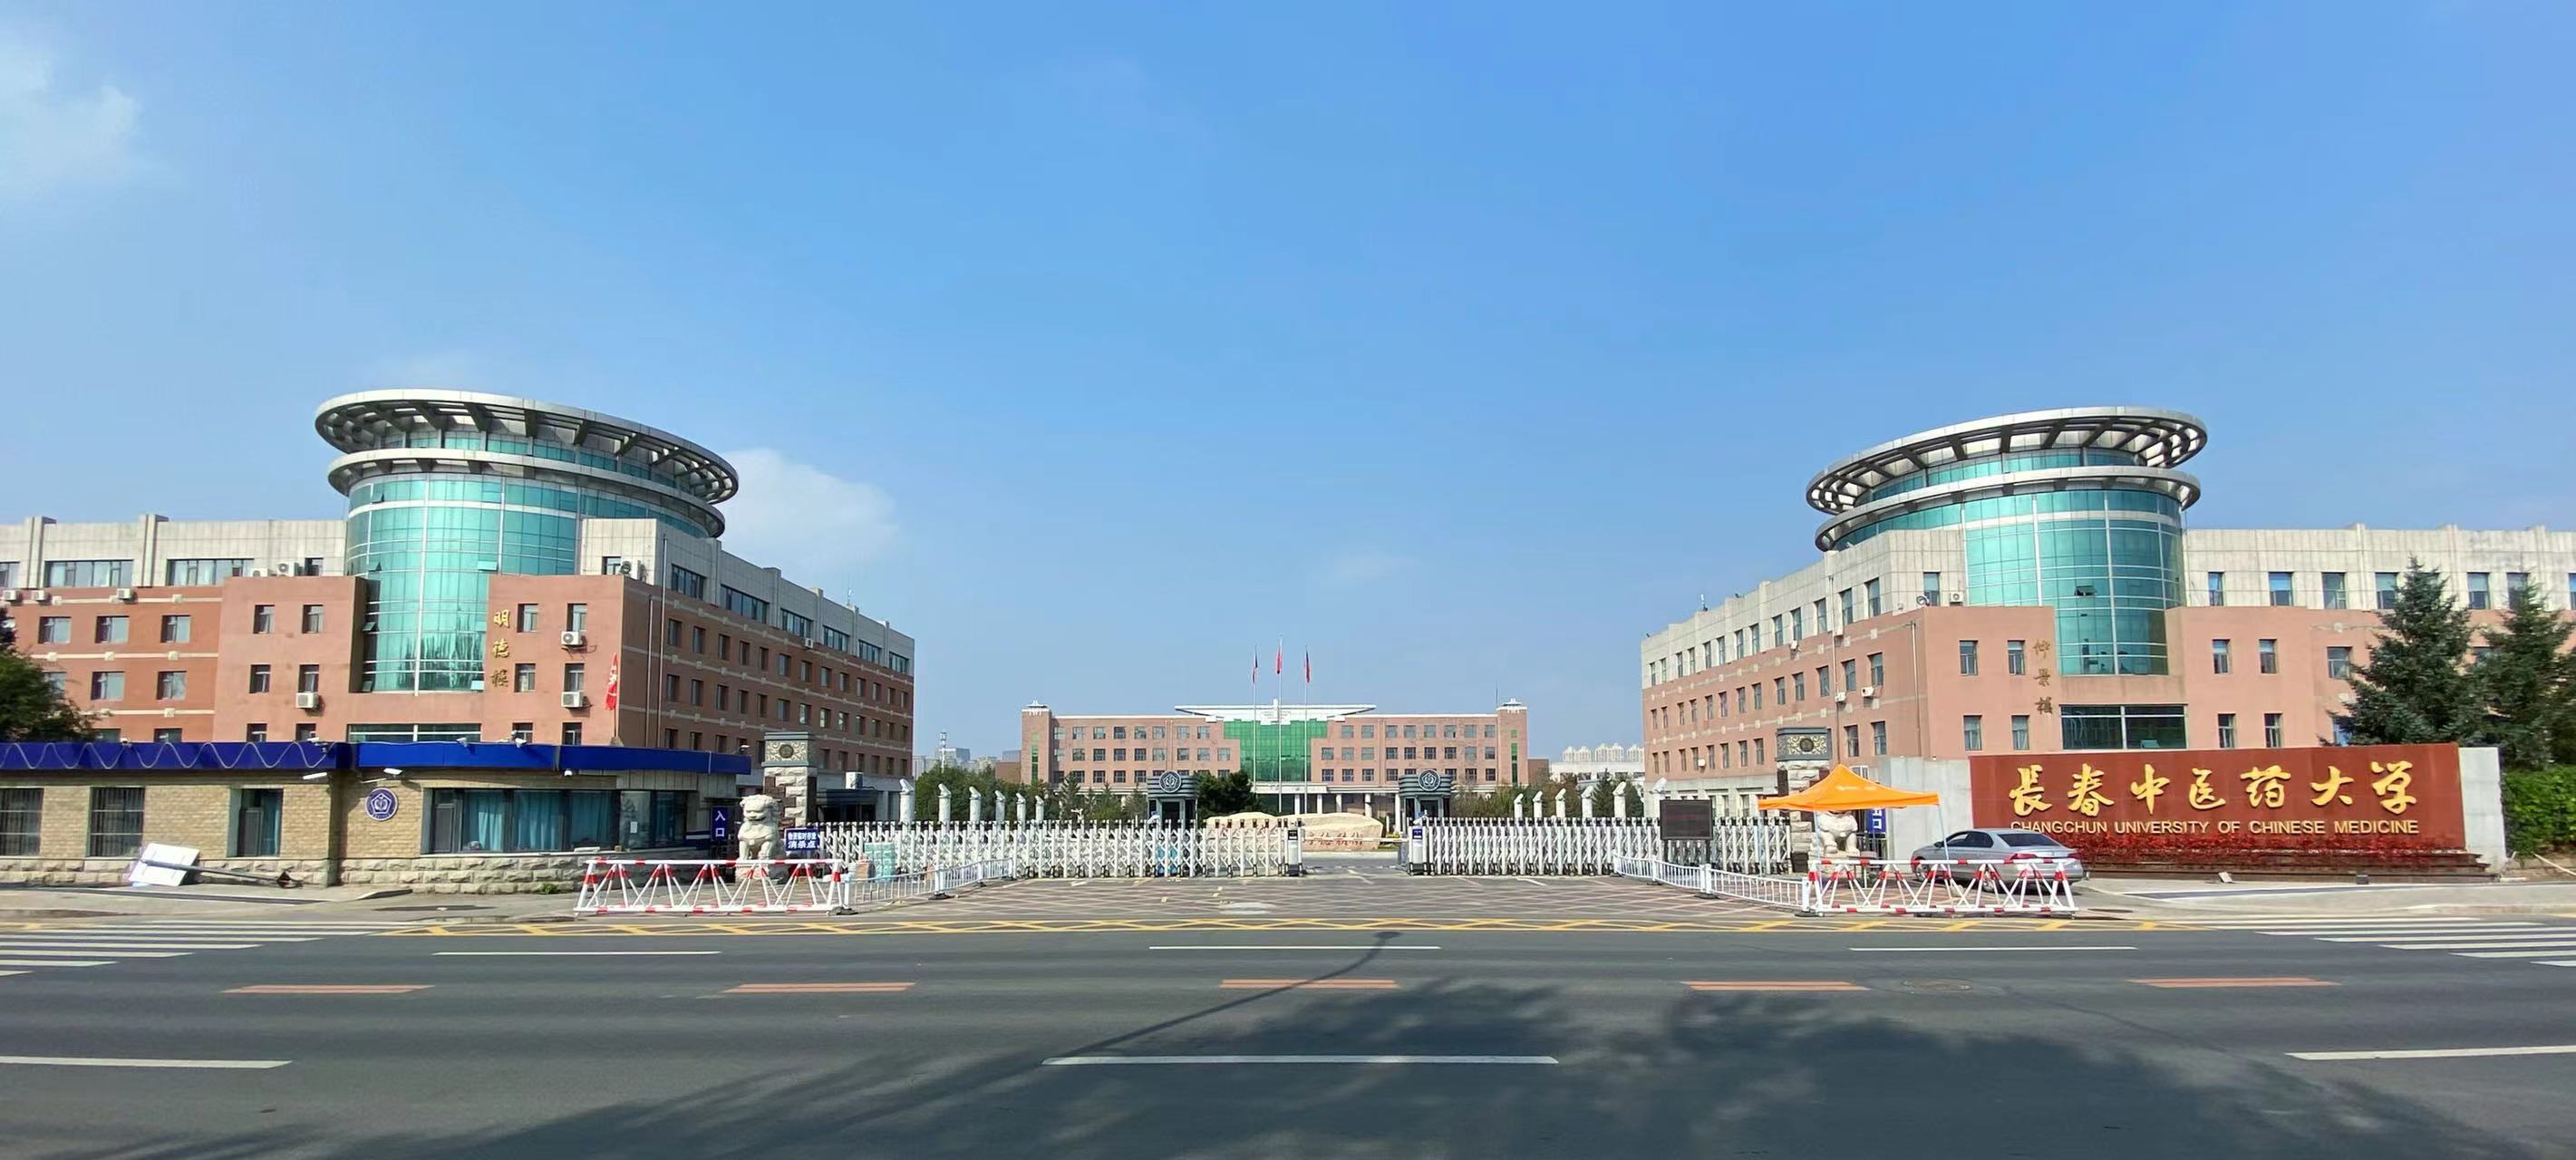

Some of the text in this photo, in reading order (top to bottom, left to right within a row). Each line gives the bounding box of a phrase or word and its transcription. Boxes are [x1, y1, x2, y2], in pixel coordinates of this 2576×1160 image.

[715, 810, 726, 837] 入口
[2010, 820, 2419, 834] CHANGCHUN UNIVERSITY OF CHINESE MEDICINE
